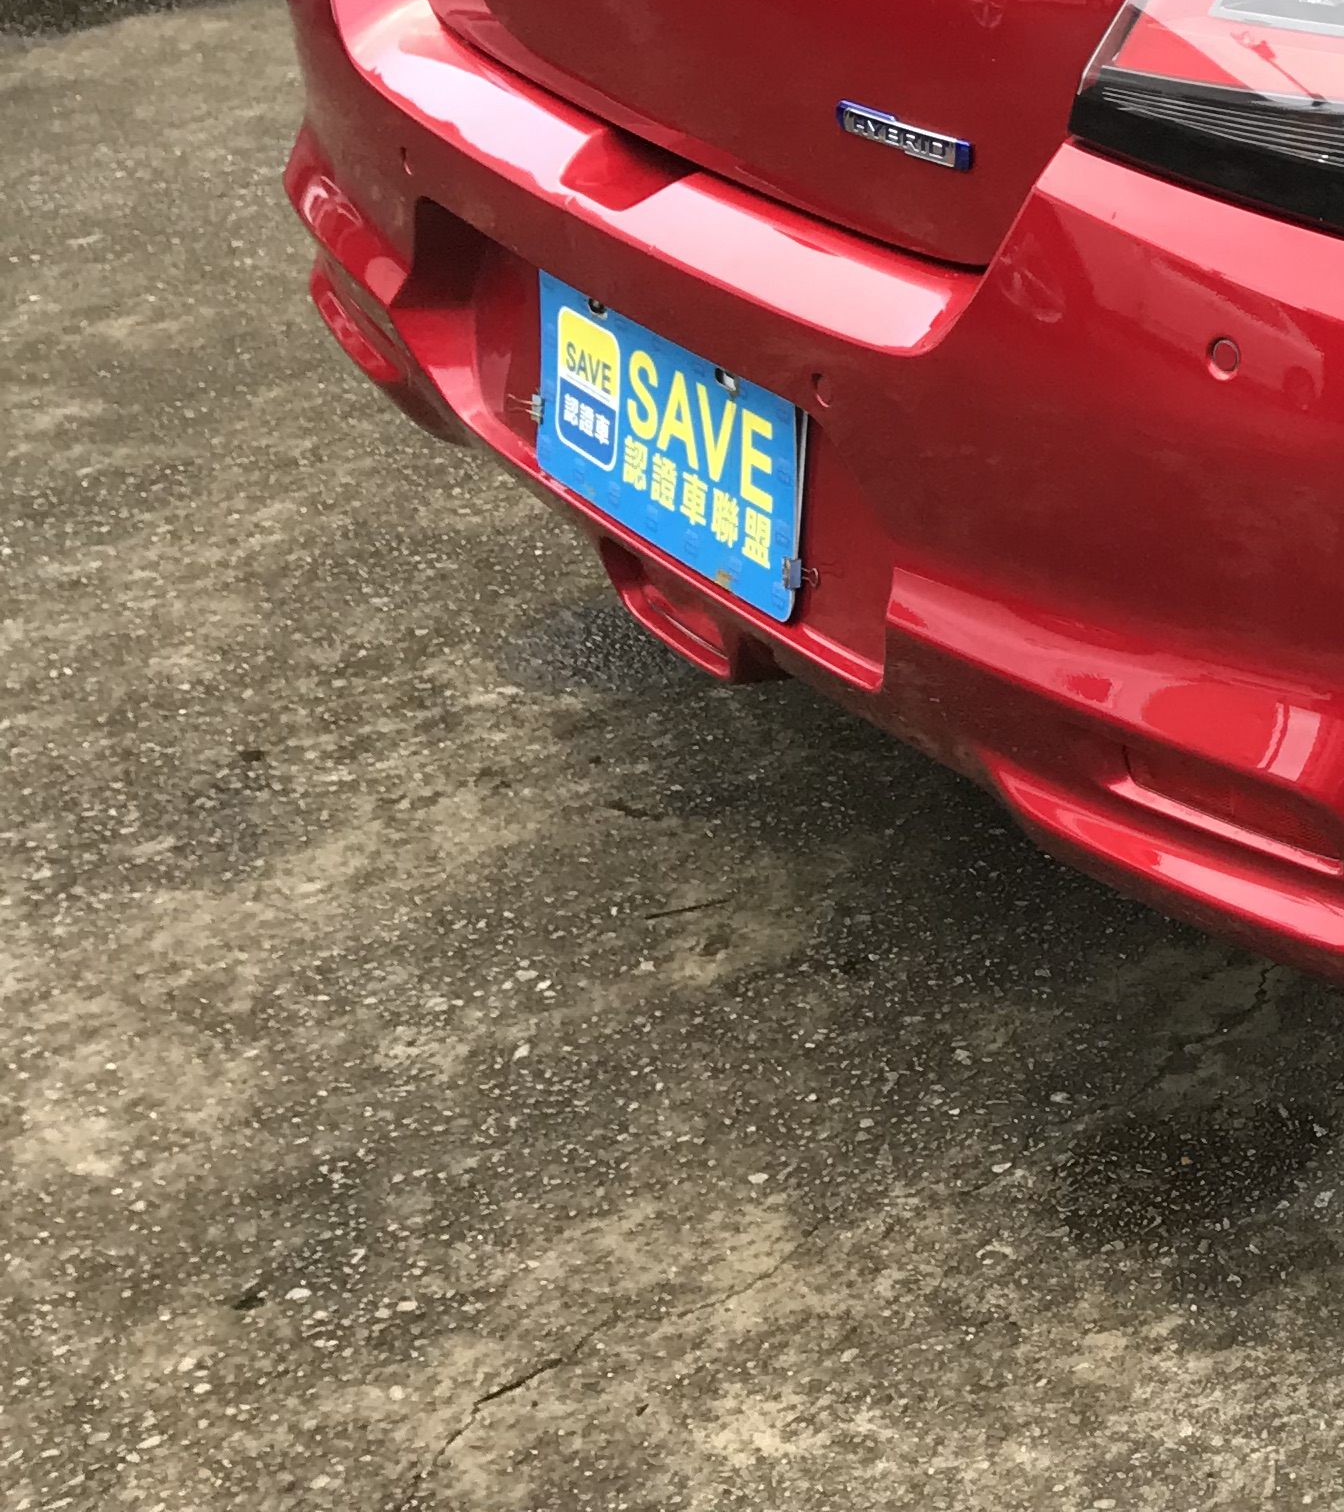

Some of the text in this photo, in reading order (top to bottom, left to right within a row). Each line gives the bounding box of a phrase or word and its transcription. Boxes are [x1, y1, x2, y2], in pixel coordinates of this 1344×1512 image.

[852, 116, 951, 160] HYBRID
[566, 341, 611, 395] SAVE
[563, 392, 610, 446] 認證車
[626, 350, 773, 514] SAVE
[622, 435, 773, 569] 認證車聯盟
